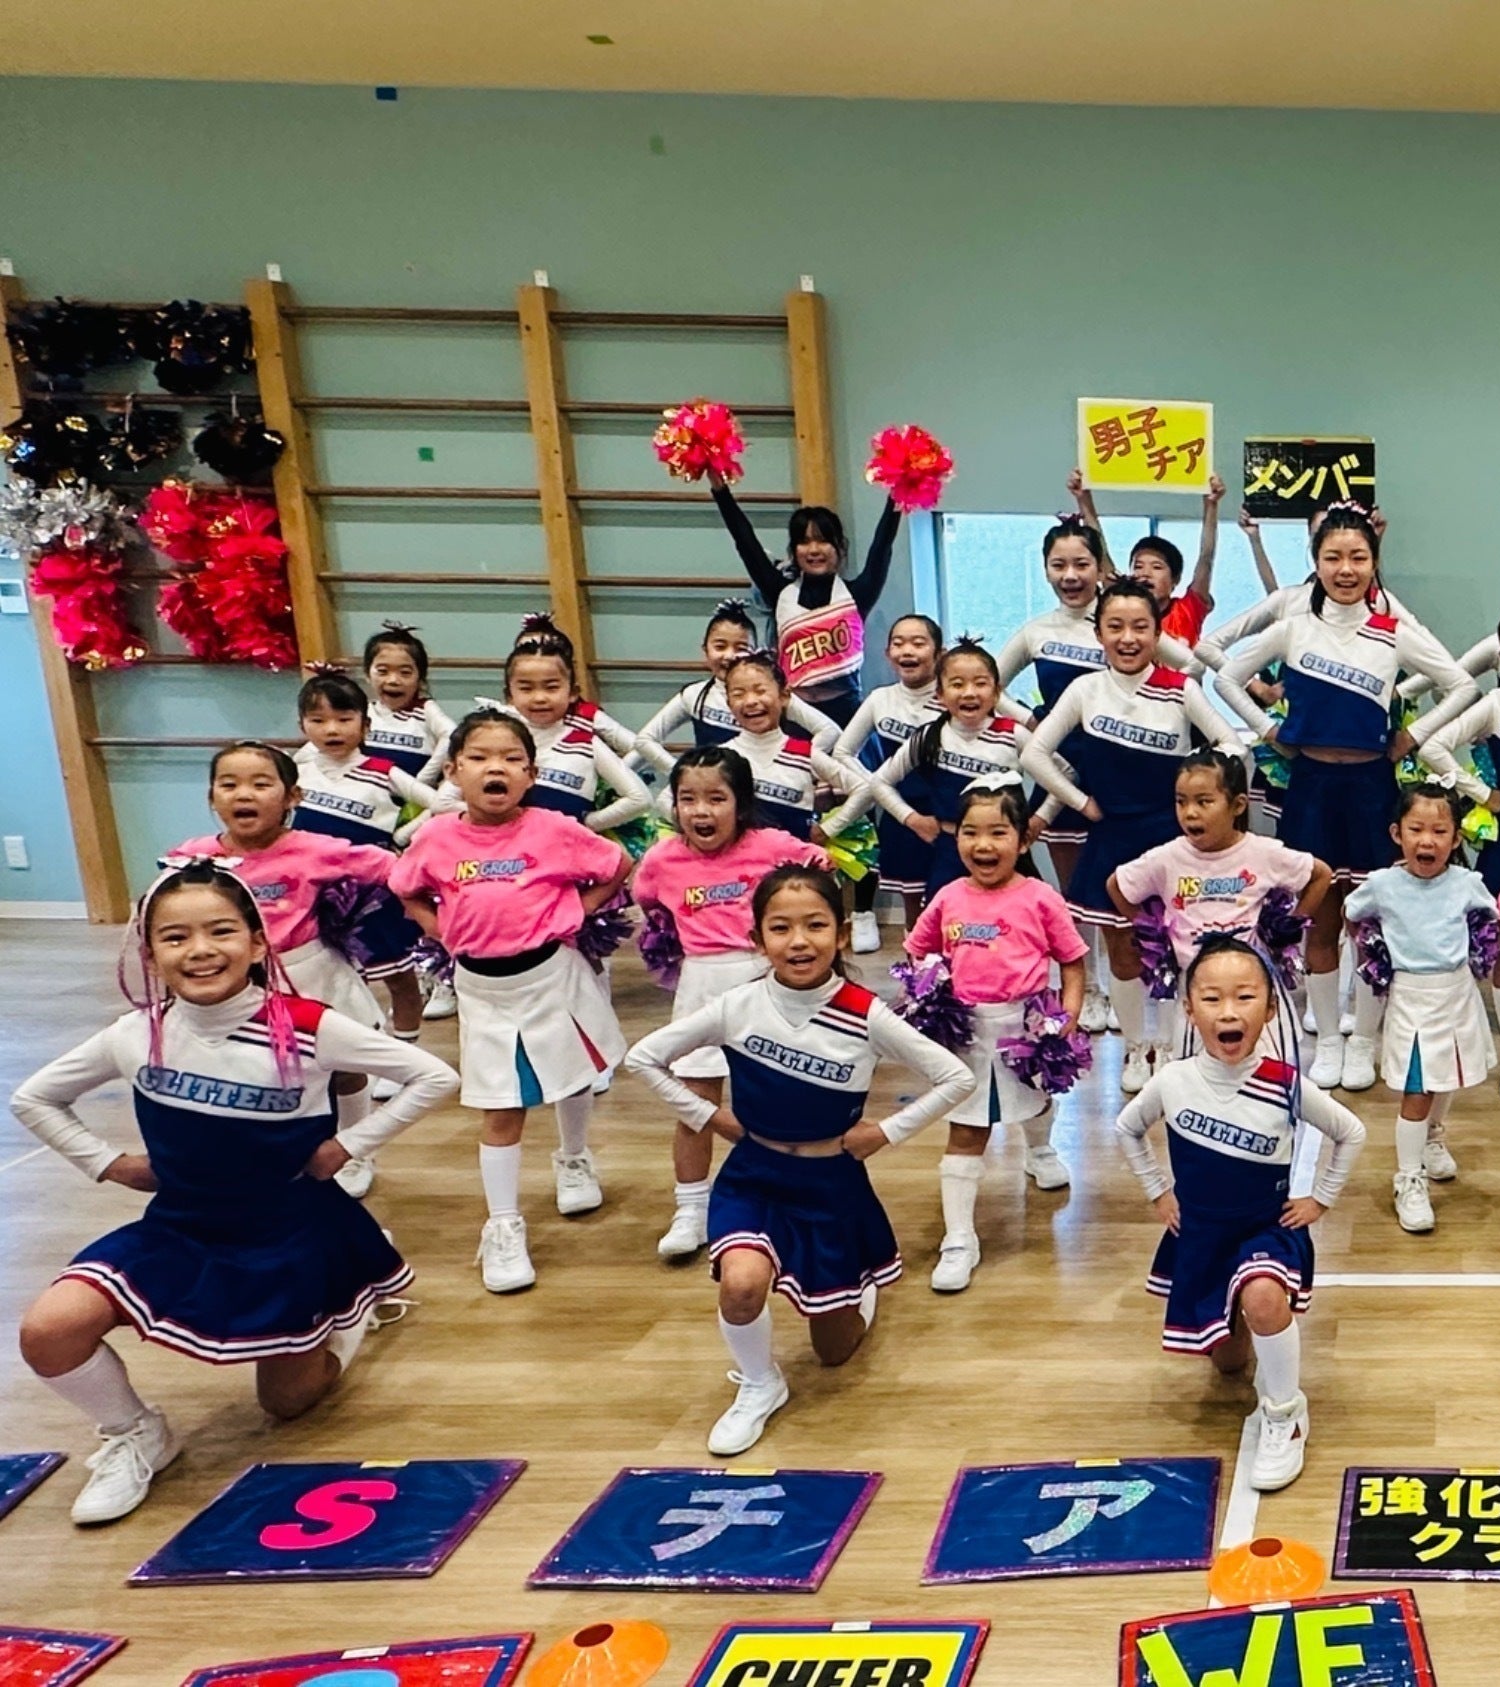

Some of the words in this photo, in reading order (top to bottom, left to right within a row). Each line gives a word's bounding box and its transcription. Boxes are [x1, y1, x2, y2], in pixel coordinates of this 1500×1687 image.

[1089, 406, 1166, 464] 男子
[1147, 438, 1205, 481] チア
[1244, 453, 1375, 501] メンバー
[785, 620, 851, 672] ZERO
[1041, 641, 1107, 665] GLITTE
[1300, 653, 1385, 696] GLITTERS
[1091, 715, 1179, 750] GLITTERS
[456, 860, 479, 881] NS
[480, 858, 526, 876] GROUP
[1179, 877, 1200, 896] NS
[1201, 877, 1246, 895] GROUP
[684, 887, 706, 905] NS
[707, 882, 747, 901] GROUP
[963, 924, 1001, 940] GROUP
[745, 1035, 853, 1083] GLITTERS
[137, 1066, 304, 1112] GLITTERS
[1176, 1109, 1278, 1156] GLITTERS
[260, 1480, 396, 1549] S
[650, 1484, 786, 1561] チ
[1022, 1480, 1156, 1553] ア
